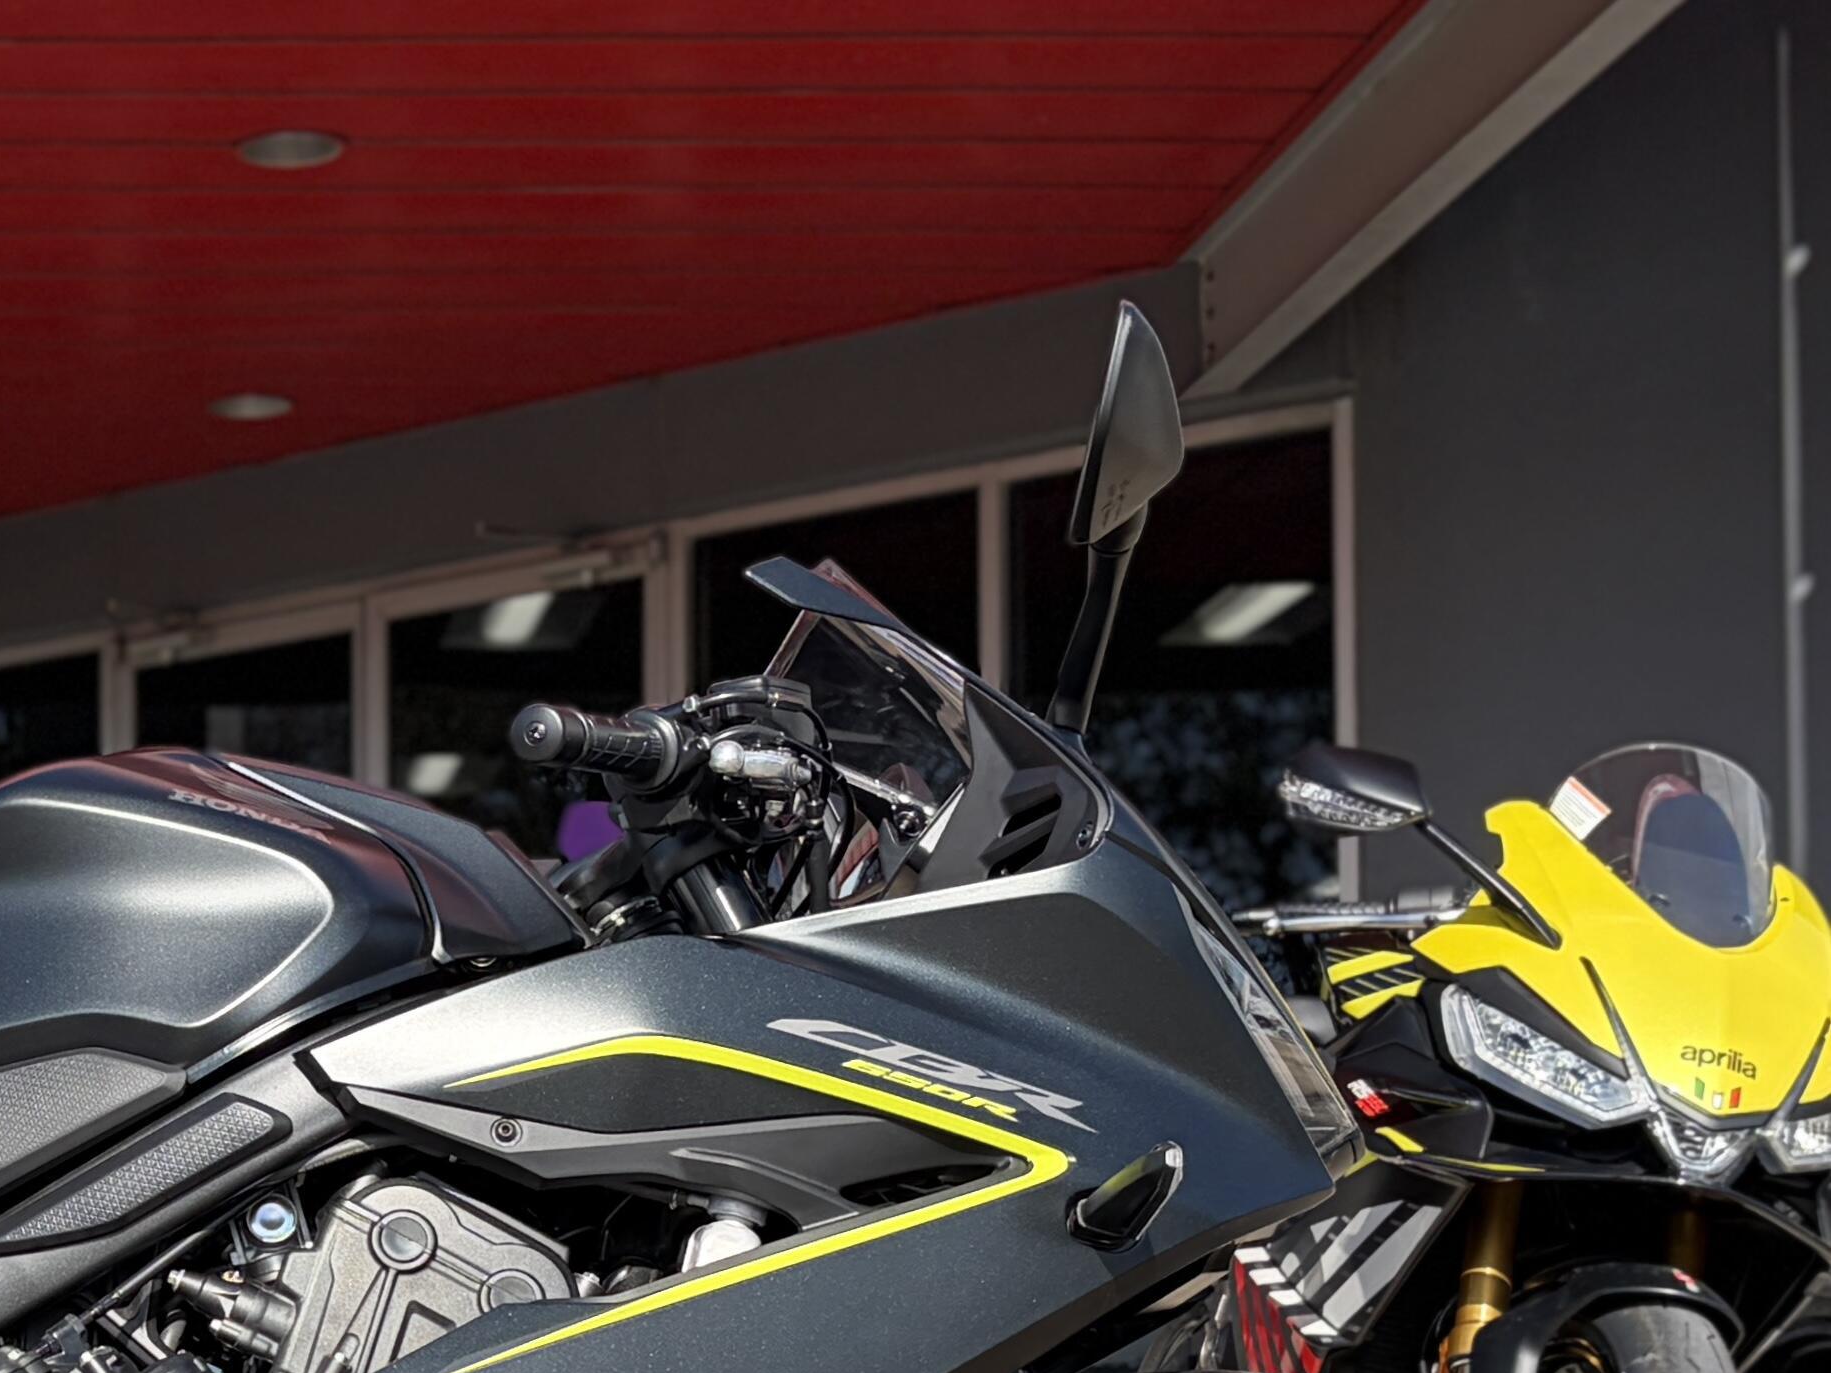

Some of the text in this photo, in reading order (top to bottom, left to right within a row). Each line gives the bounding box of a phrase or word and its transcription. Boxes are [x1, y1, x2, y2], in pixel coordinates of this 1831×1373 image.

[168, 788, 331, 845] HONDA
[766, 1018, 1100, 1133] CBR
[842, 1059, 1019, 1122] 650R
[1680, 1045, 1757, 1080] aprilia
